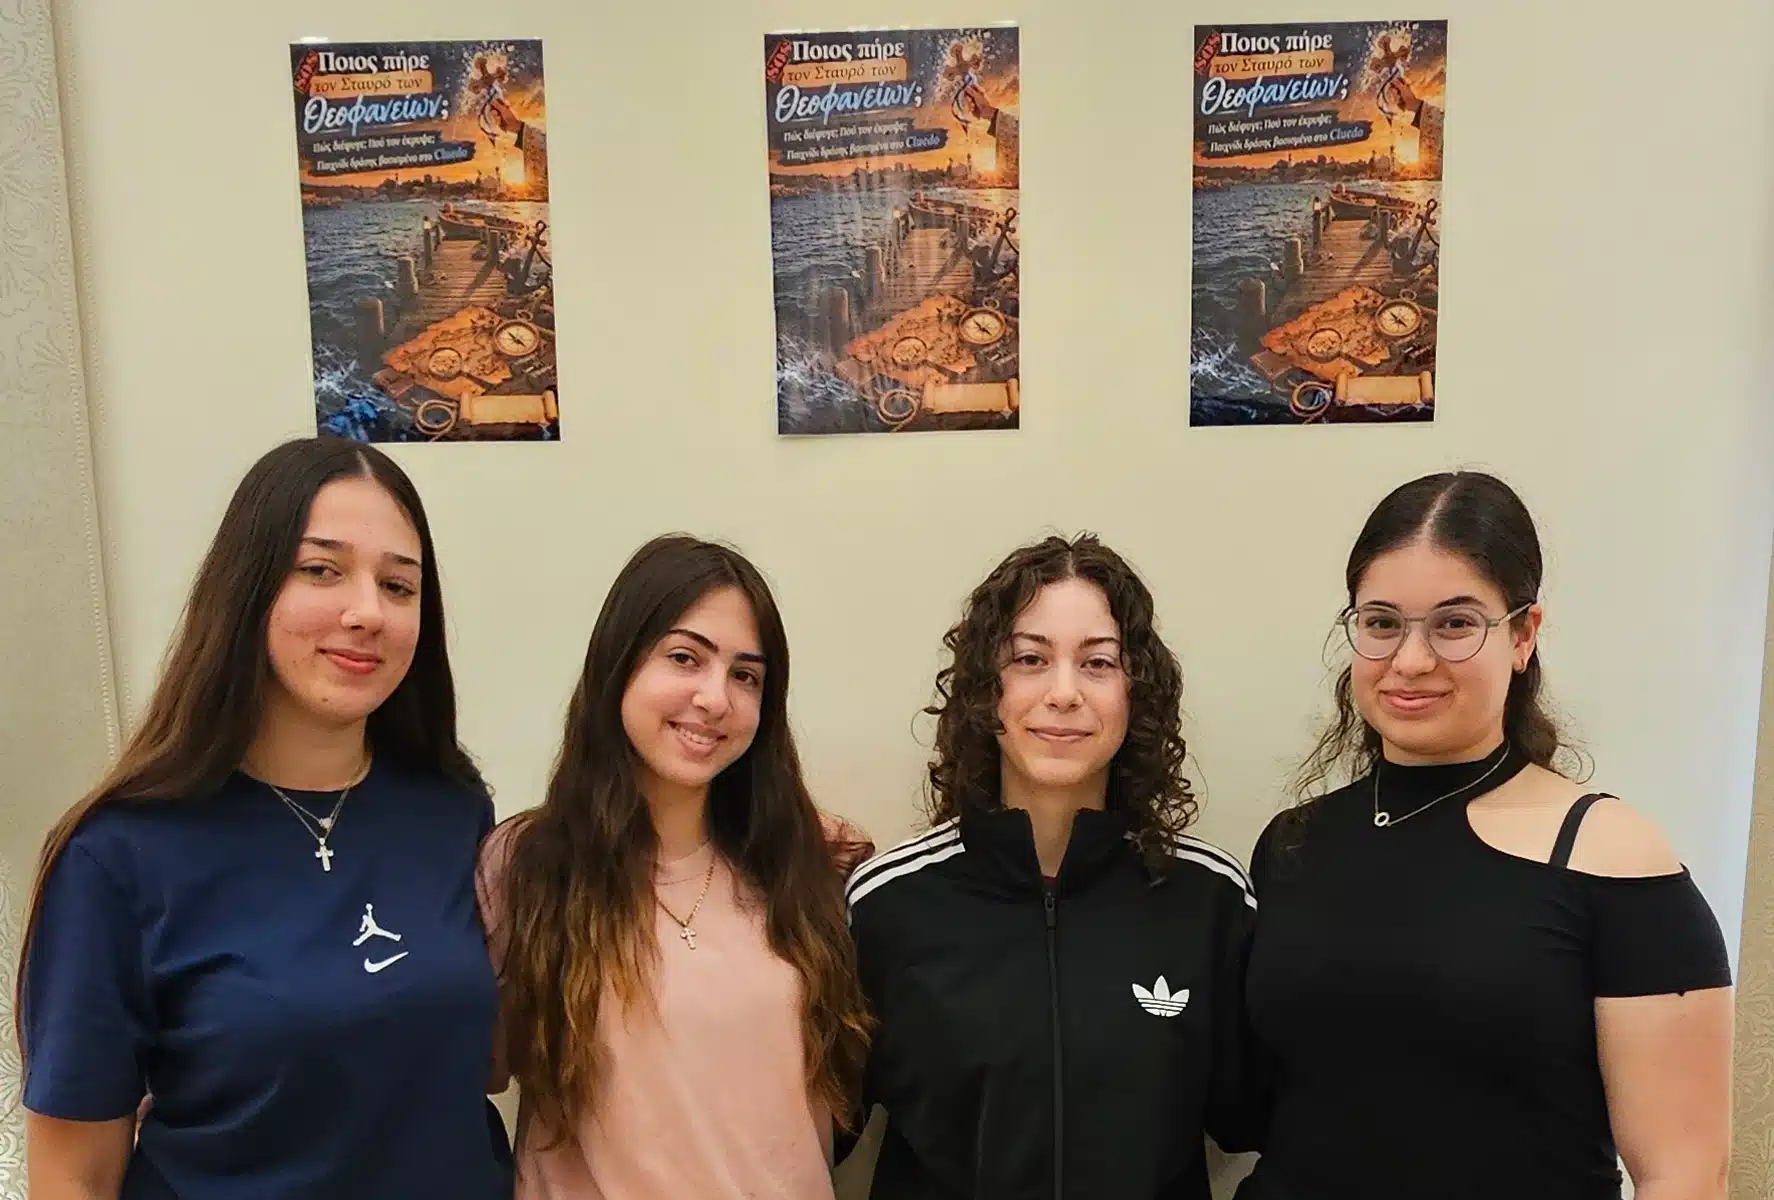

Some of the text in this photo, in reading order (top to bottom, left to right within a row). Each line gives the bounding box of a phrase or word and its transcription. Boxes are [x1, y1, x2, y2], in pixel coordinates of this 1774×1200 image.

[792, 38, 905, 61] Ποιος πήρε
[1195, 32, 1220, 71] SOS
[1221, 30, 1332, 54] Ποιος πήρε
[319, 51, 430, 74] Ποιος πήρε
[767, 42, 791, 79] SOS
[1215, 58, 1324, 73] τον Σταυρό των
[314, 77, 422, 93] τον Σταυρό των
[788, 66, 897, 81] τον Σταυρό των
[776, 81, 922, 125] Θεοφανείων;
[1201, 73, 1349, 117] Θεοφανείων;
[303, 93, 449, 136] Θεοφανείων;
[1209, 123, 1227, 134] Πώς
[1283, 119, 1296, 127] τον
[1330, 127, 1363, 140] Cluedo
